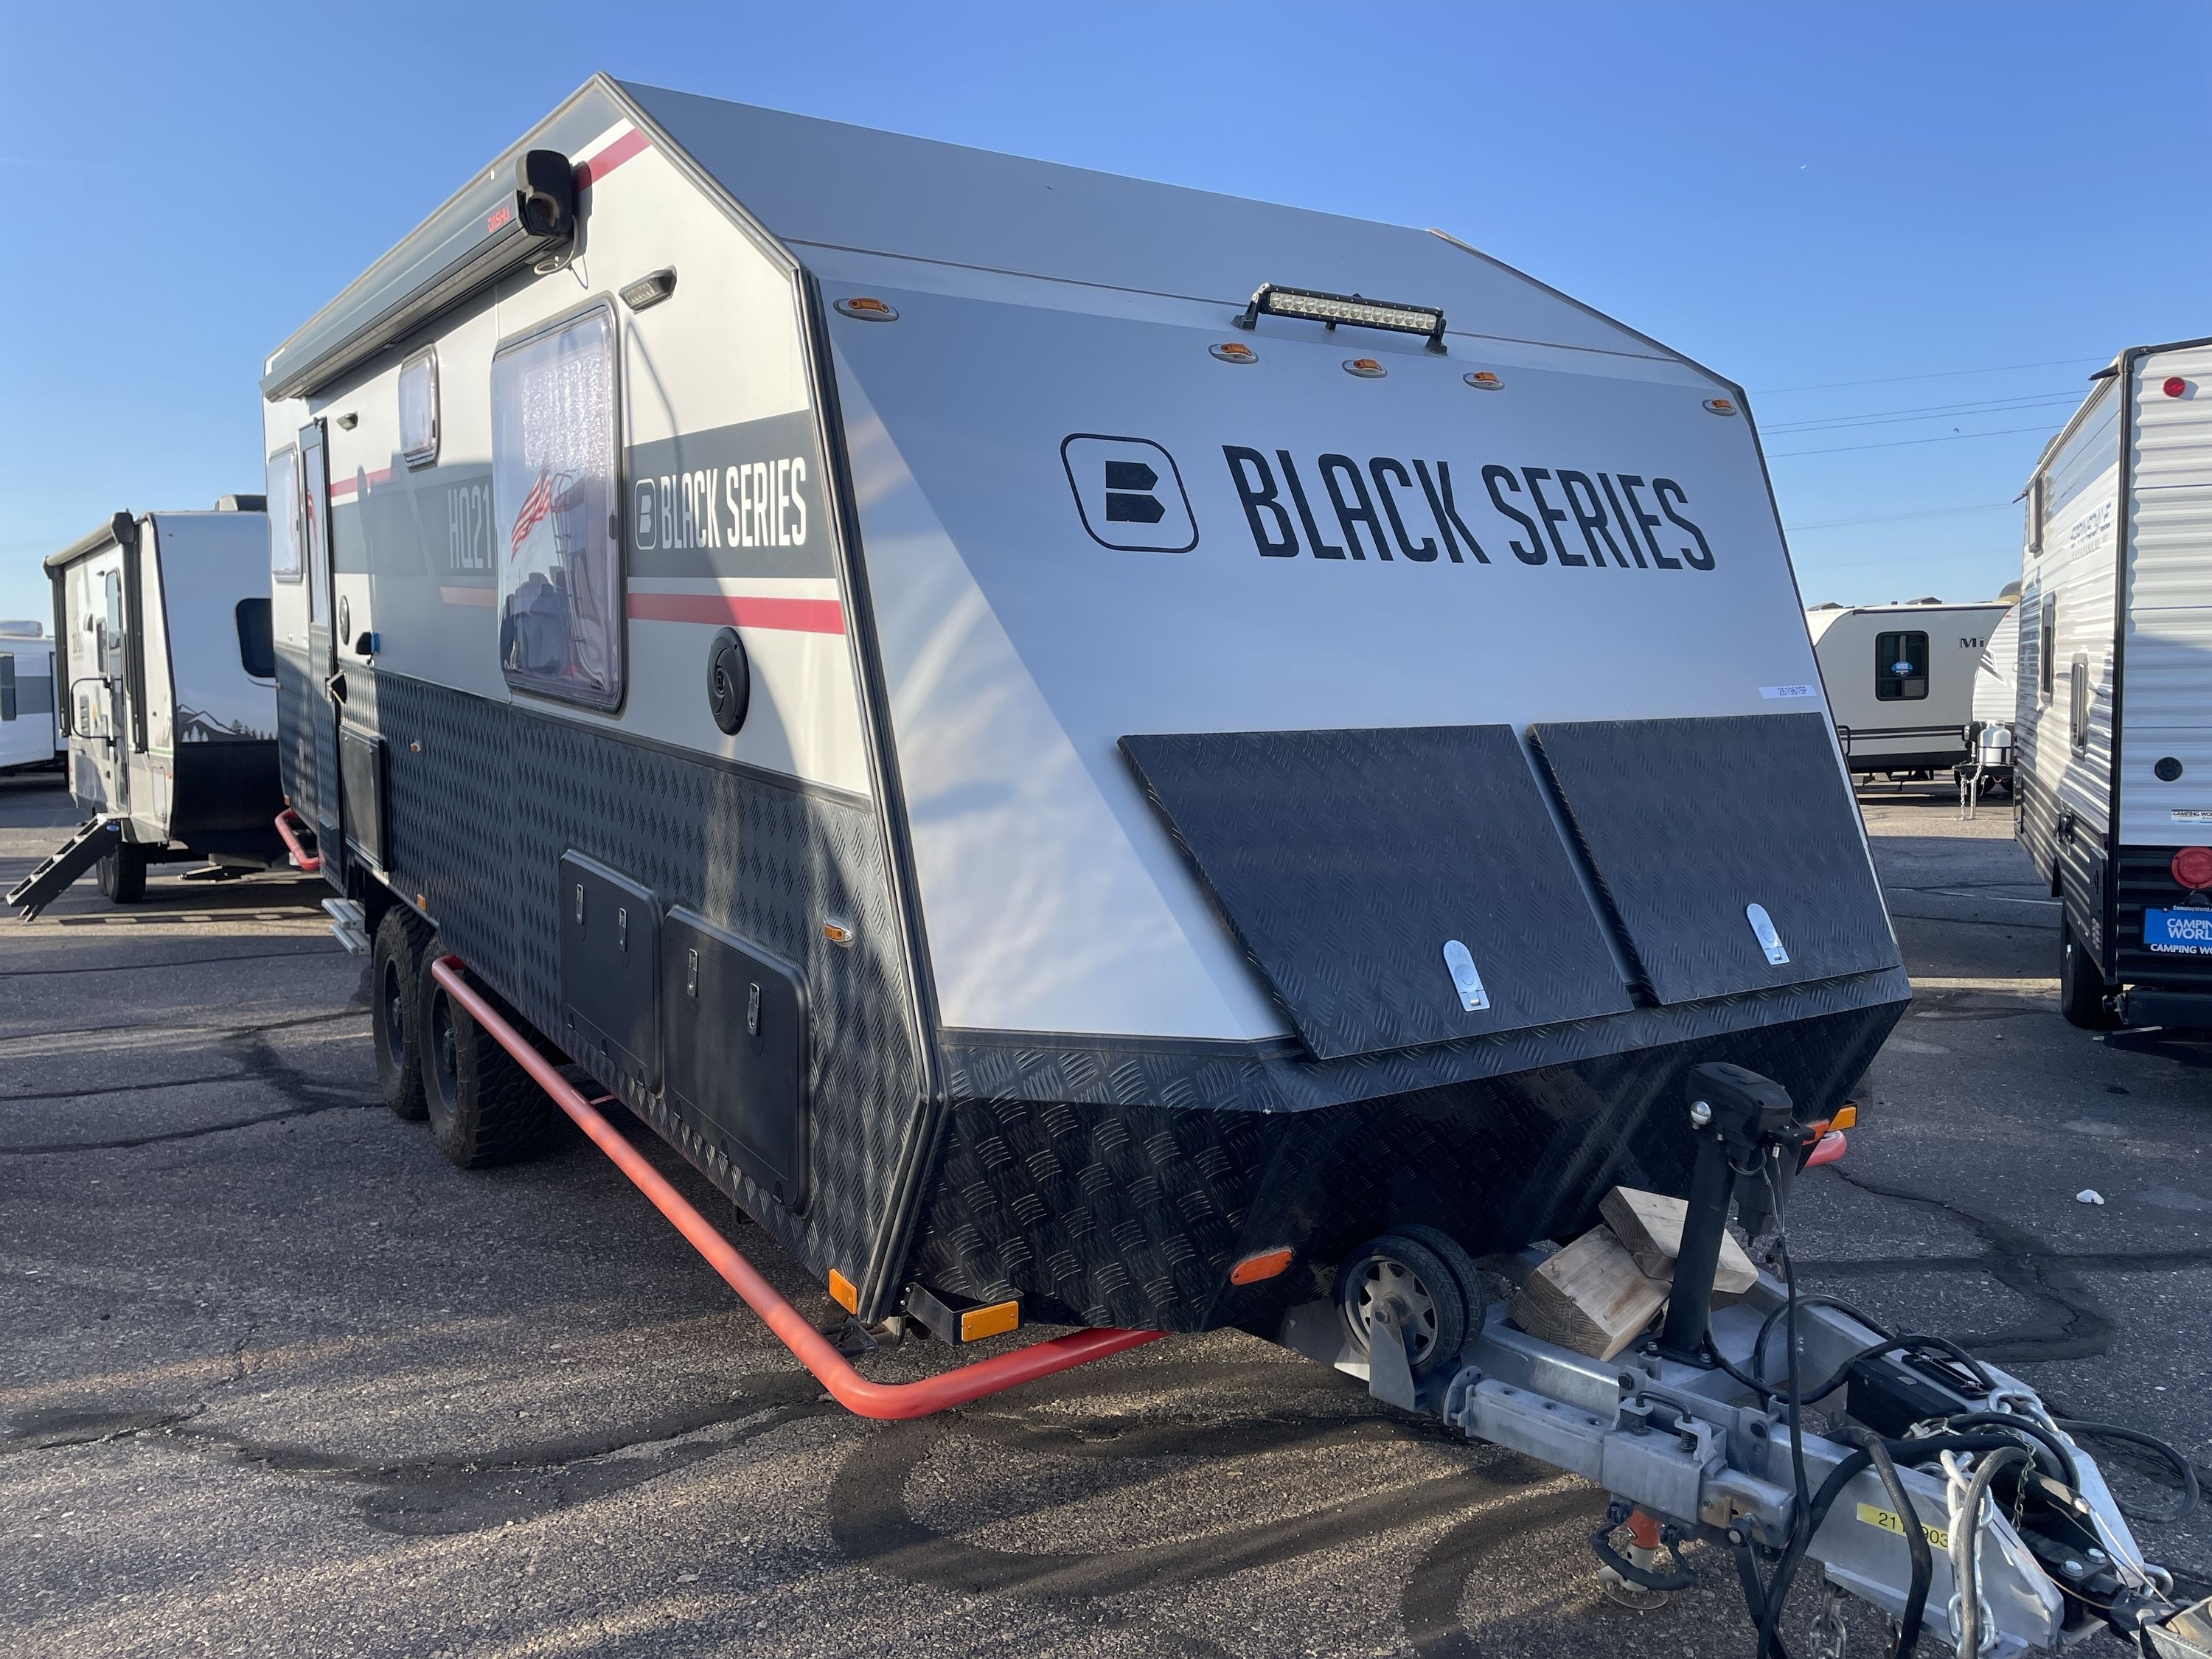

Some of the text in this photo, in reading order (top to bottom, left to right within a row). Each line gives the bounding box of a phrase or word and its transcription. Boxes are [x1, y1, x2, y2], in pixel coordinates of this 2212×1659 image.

[448, 484, 492, 568] HQ21
[661, 468, 721, 549] BLACK
[726, 457, 807, 548] SERIES
[1222, 445, 1492, 564] BLACK
[1481, 465, 1716, 570] SERIES
[2150, 944, 2197, 954] CAMPING
